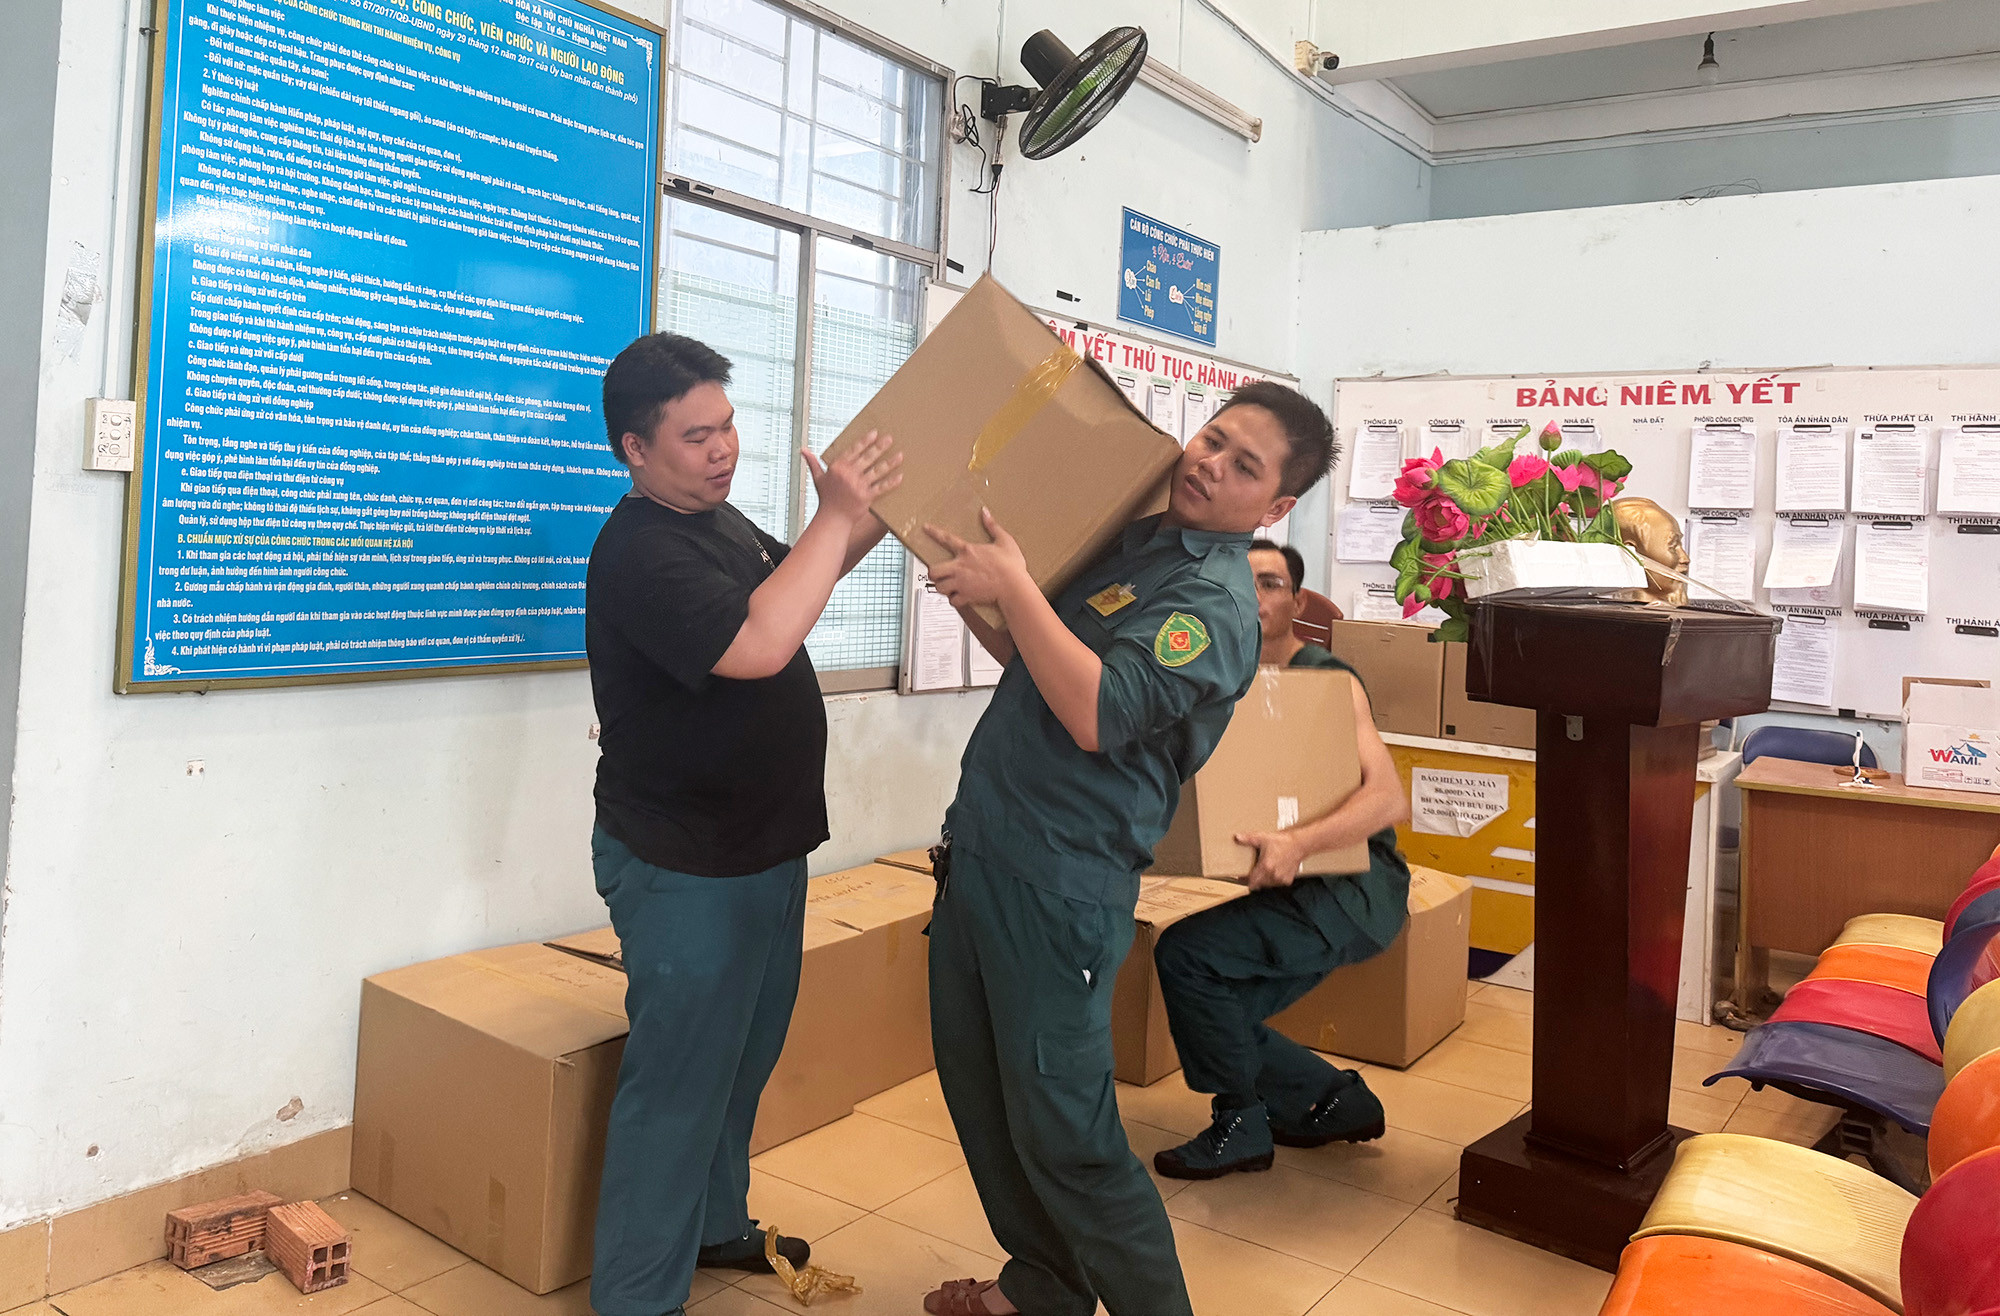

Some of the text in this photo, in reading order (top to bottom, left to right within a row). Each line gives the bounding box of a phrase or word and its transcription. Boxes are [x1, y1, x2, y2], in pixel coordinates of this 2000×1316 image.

[362, 0, 638, 104] 67/2017/QĐ-UBND ngày 29 tháng 12 năm 2017 của Ủy ban nhân dân thành phố)
[444, 9, 477, 35] CHỨC,
[480, 21, 503, 42] VIÊN
[505, 31, 534, 52] CHỨC
[535, 40, 548, 58] VÀ
[550, 46, 579, 69] NGƯỜI
[581, 58, 598, 76] LAO
[600, 64, 624, 85] ĐỘNG
[1082, 333, 1116, 363] YẾT
[1122, 345, 1155, 373] THỦ
[1162, 354, 1193, 384] TỤC
[1198, 361, 1237, 391] HÀNH
[1516, 374, 1800, 407] BẢNG NIÊM YẾT
[1778, 415, 1793, 423] TÒA
[1808, 415, 1830, 423] NHÂN
[1831, 415, 1848, 423] DÂN
[1864, 414, 1888, 422] THỪA
[1891, 414, 1916, 422] PHÁT
[154, 627, 271, 642] việc theo quy định của pháp luật.
[1930, 749, 1978, 765] WAMI
